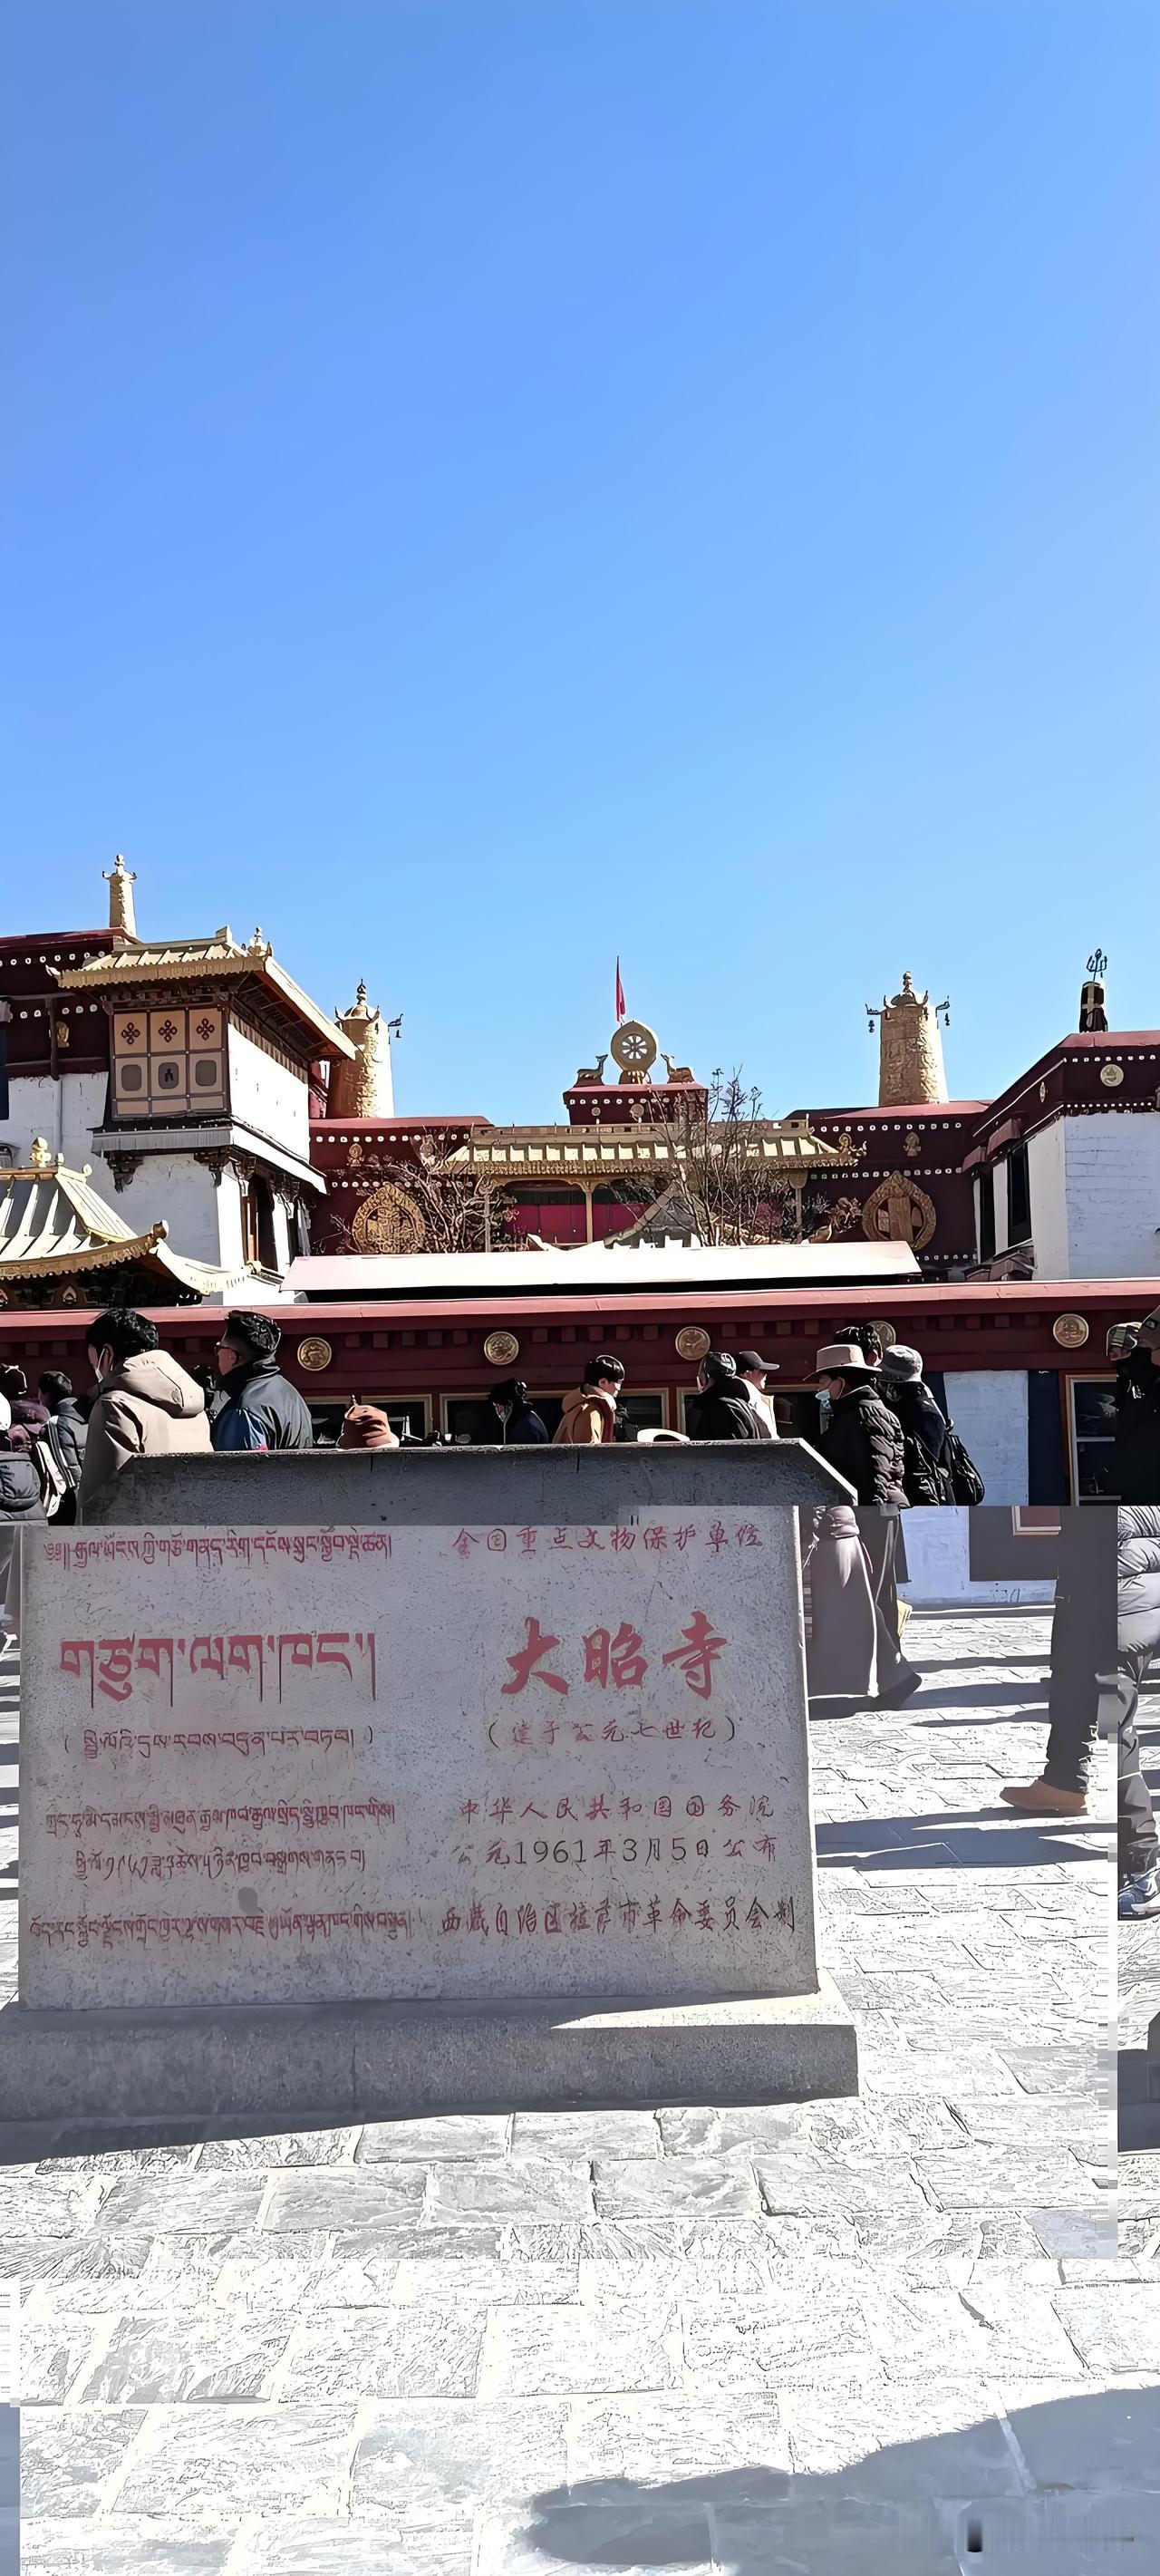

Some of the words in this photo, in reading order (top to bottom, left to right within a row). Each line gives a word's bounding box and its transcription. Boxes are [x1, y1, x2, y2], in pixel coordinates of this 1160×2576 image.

[453, 1522, 763, 1554] 全国重点文物保护单位
[501, 1611, 728, 1700] 大昭寺
[459, 1795, 774, 1824] 中华人民共和国国务院
[453, 1835, 777, 1864] 公元1961年3月5日公布
